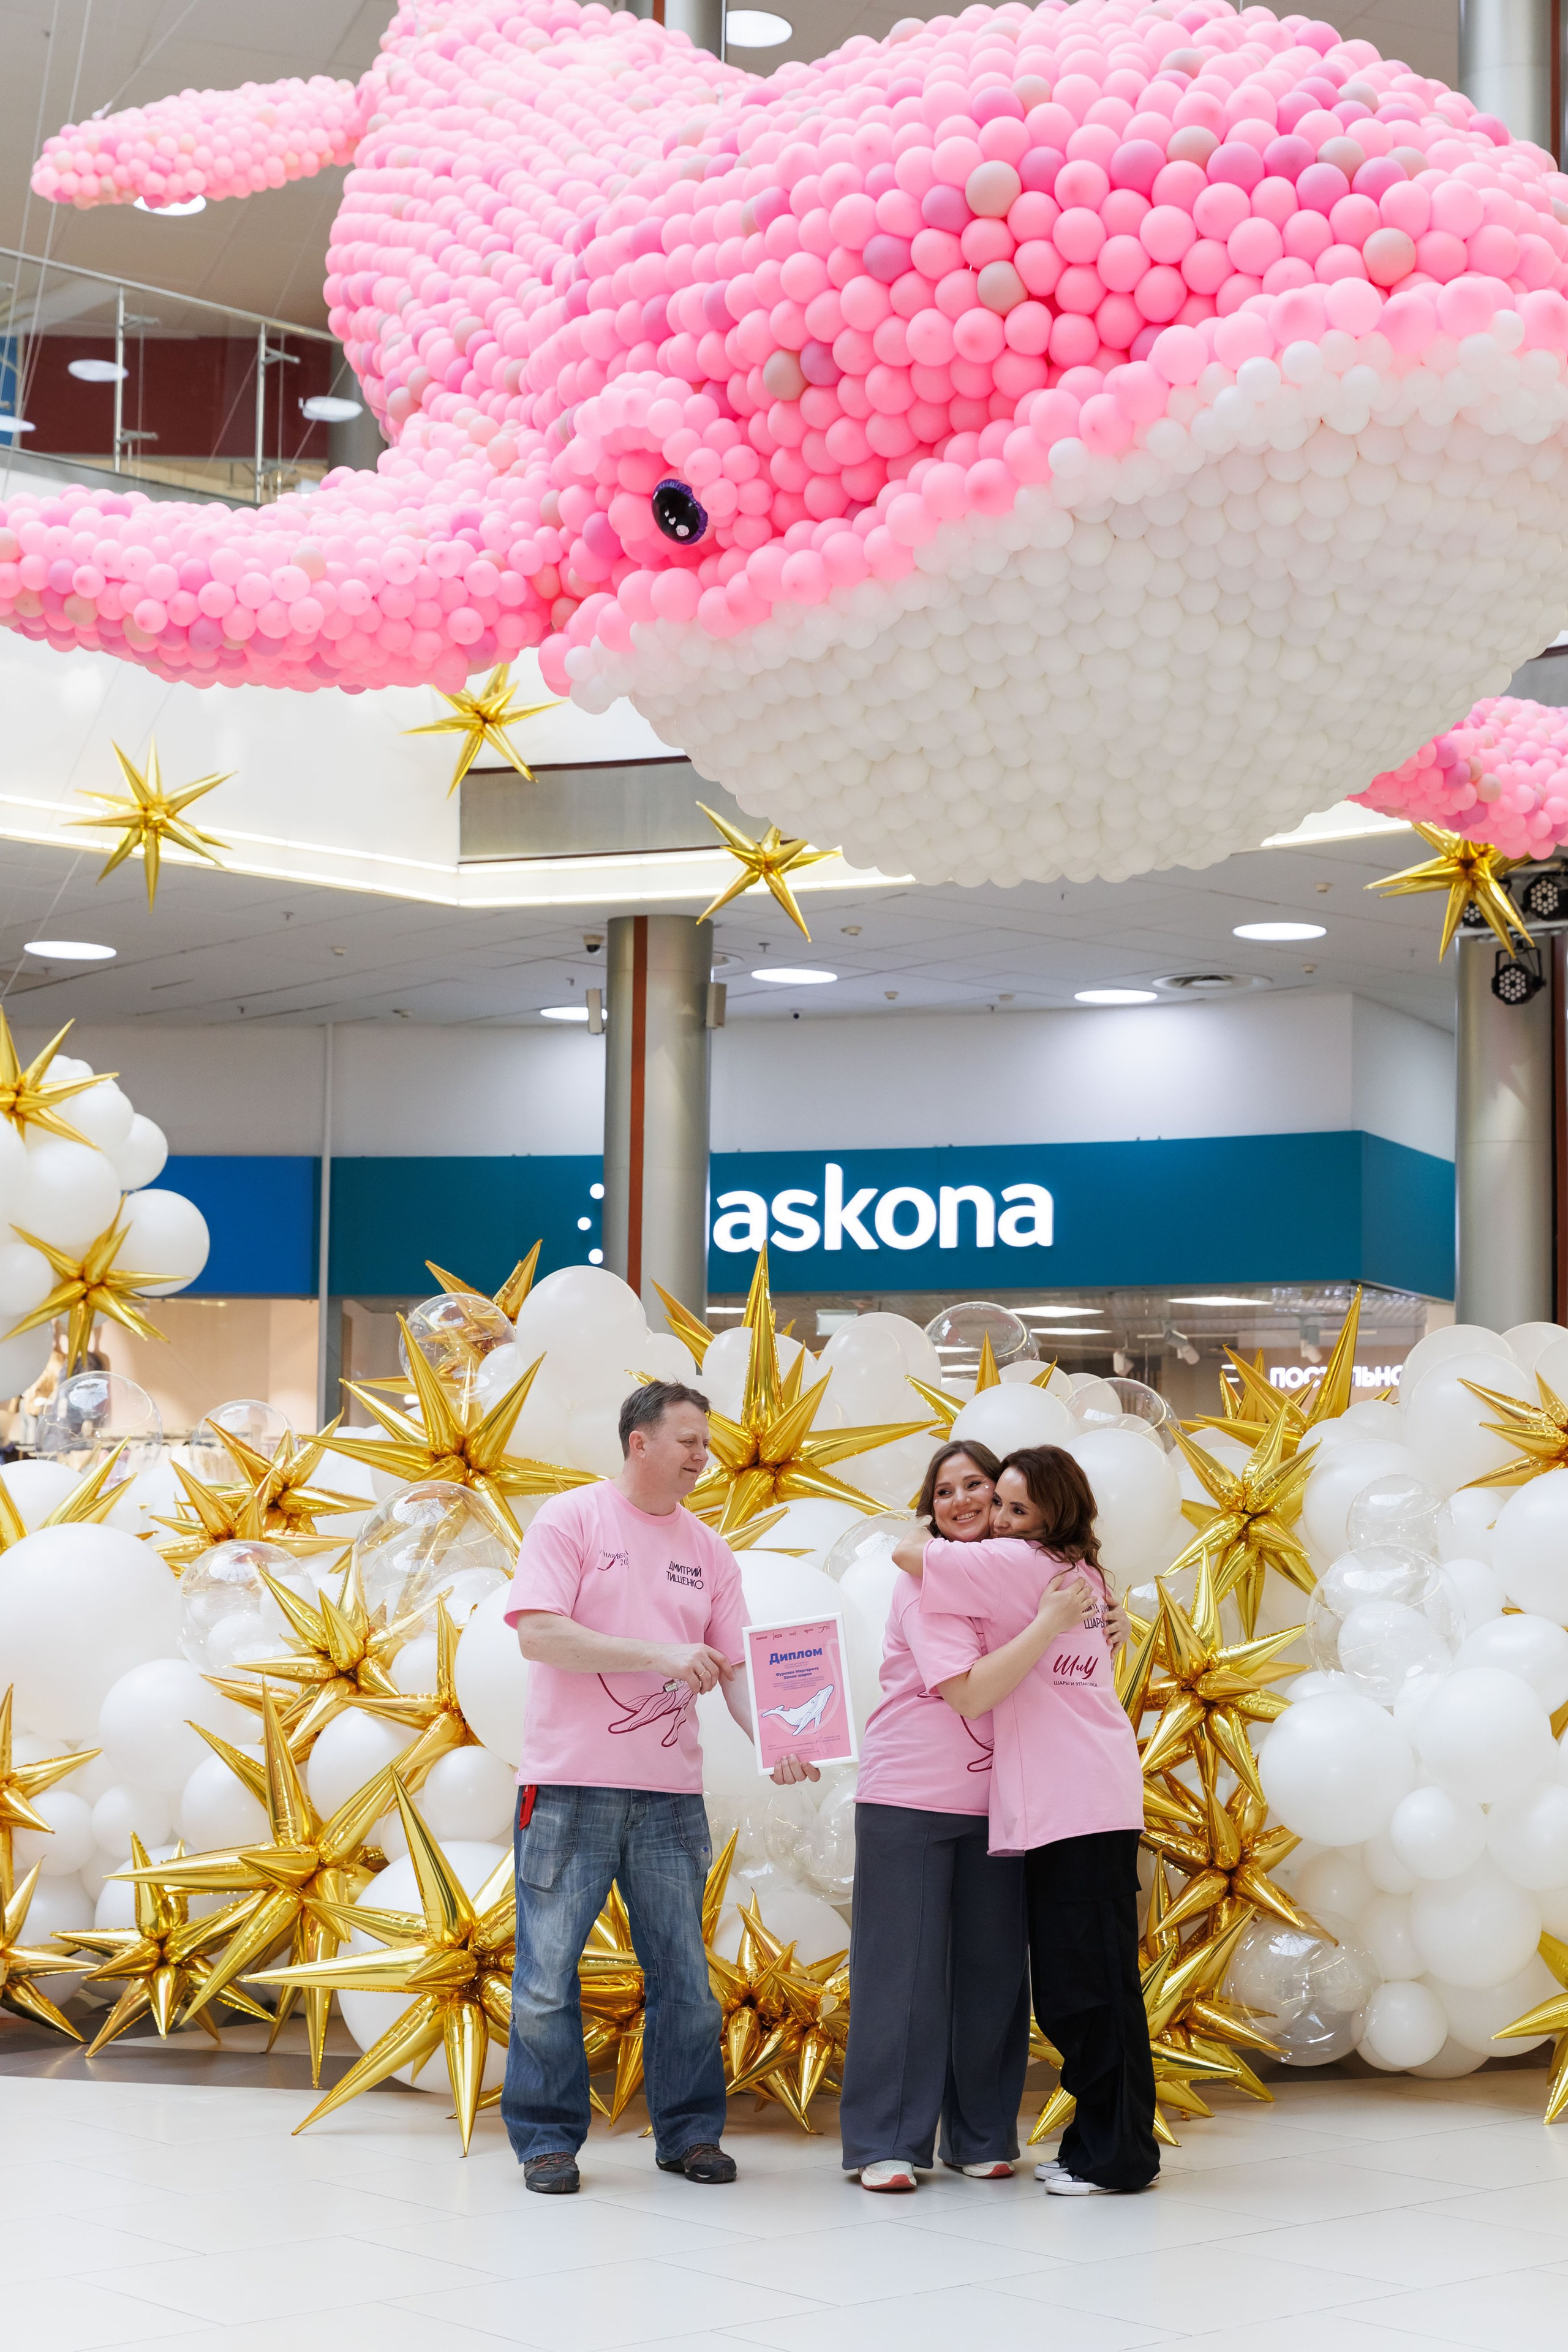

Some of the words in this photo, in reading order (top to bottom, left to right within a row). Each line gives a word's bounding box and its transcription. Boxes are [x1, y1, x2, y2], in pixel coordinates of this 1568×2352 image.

[713, 1163, 1055, 1253] askona
[669, 1561, 702, 1577] ДМИТРИЙ
[666, 1570, 704, 1589] ТИЩЕНКО
[769, 1648, 823, 1665] Диплом
